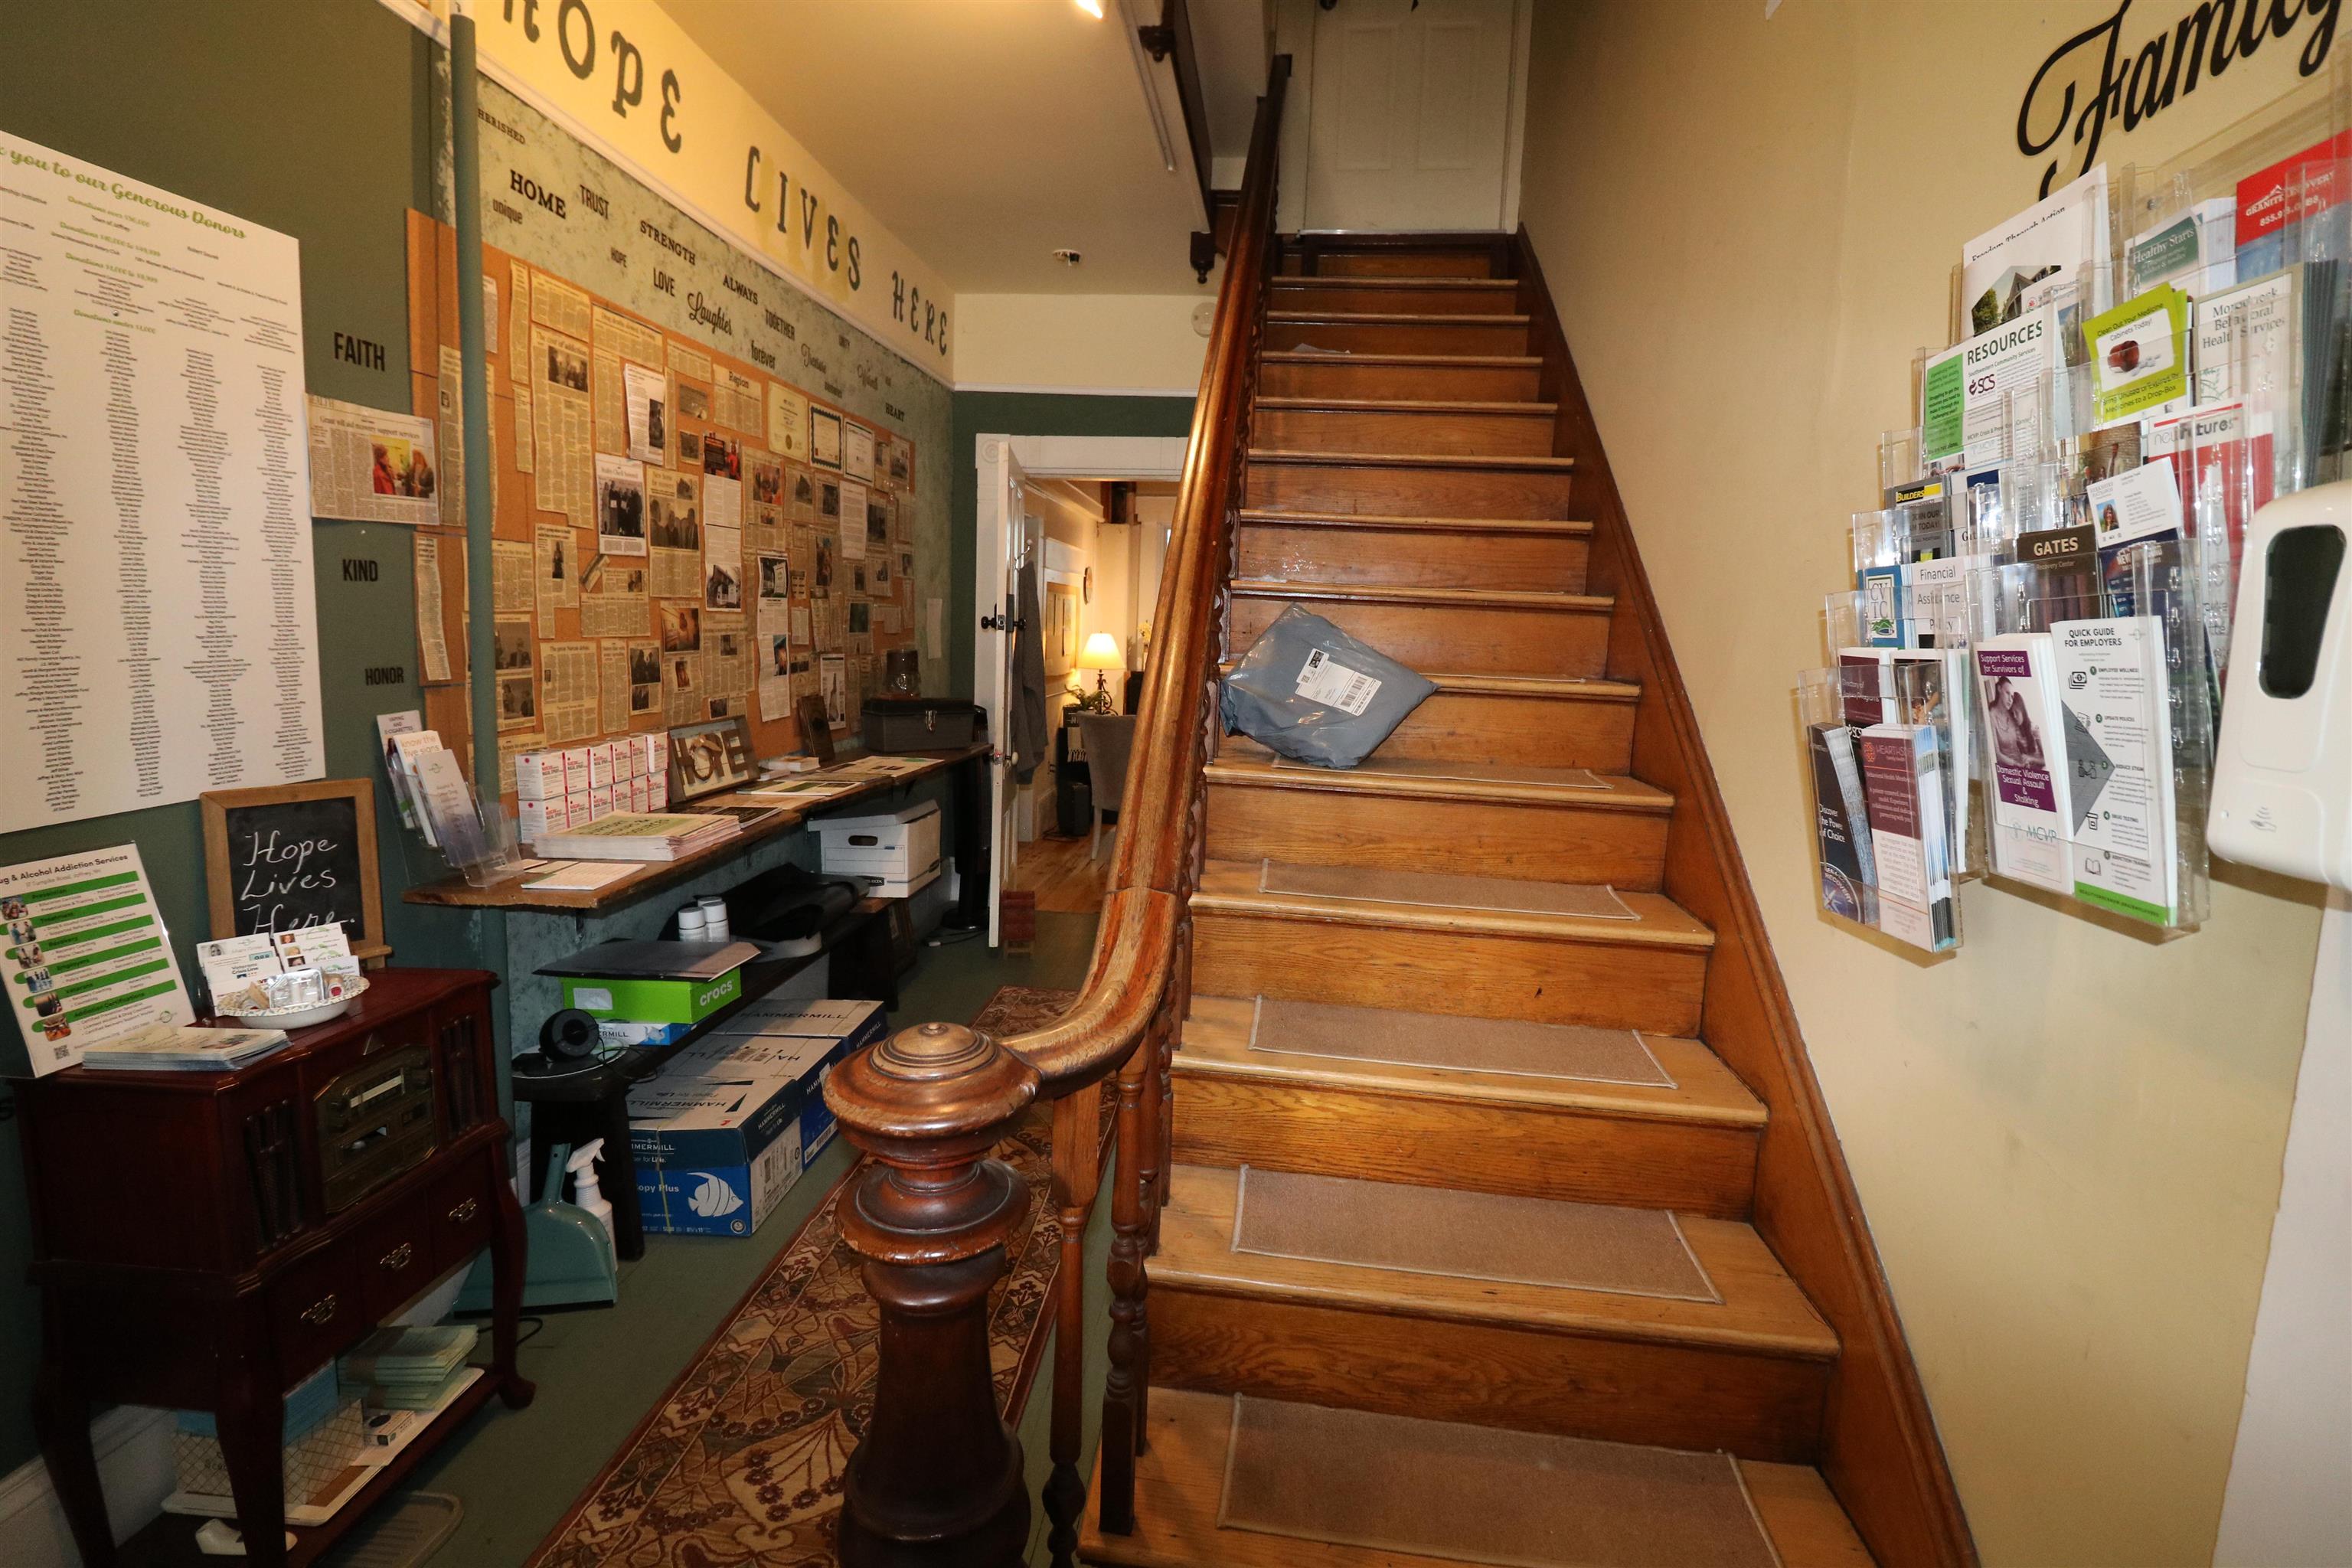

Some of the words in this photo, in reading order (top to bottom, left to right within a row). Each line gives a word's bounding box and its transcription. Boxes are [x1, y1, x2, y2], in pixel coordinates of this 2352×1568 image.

[478, 108, 526, 145] HERISHED
[11, 150, 50, 172] you
[52, 162, 72, 178] to
[75, 174, 109, 191] our
[111, 182, 189, 220] Generous
[191, 211, 247, 240] Donors
[510, 169, 566, 219] HOME
[580, 184, 609, 220] TRUST
[2246, 193, 2285, 217] GRANITE
[492, 198, 523, 224] unique
[640, 220, 696, 266] STRENGTH
[2133, 240, 2169, 264] Healthy
[2168, 229, 2197, 246] Starts
[610, 247, 628, 268] HOPE
[653, 267, 675, 297] LOVE
[722, 274, 759, 305] ALWAYS
[687, 291, 732, 335] Laughter
[892, 270, 947, 356] HERE
[2097, 323, 2115, 337] Clean
[2115, 321, 2125, 331] Out
[2125, 315, 2138, 326] Your
[2138, 302, 2164, 320] Medicine
[765, 309, 795, 341] TOGETHER
[2110, 328, 2133, 341] Cabinets
[334, 332, 386, 371] FAITH
[1967, 320, 2043, 365] RESOURCES
[751, 340, 776, 371] forever
[1968, 364, 1994, 378] Southwestern
[1994, 354, 2018, 370] Community
[2018, 347, 2037, 360] Services
[729, 371, 750, 389] Region
[1978, 374, 1996, 394] SCS
[2147, 385, 2177, 400] Drop-Box
[885, 403, 906, 422] HEART
[1896, 489, 1925, 503] BUILDERS
[2034, 537, 2079, 557] GATES
[342, 558, 378, 582] KIND
[1920, 566, 1956, 581] Financial
[1870, 601, 1889, 618] TC
[2064, 639, 2078, 648] FOR
[2080, 638, 2122, 647] EMPLOYERS
[2069, 629, 2092, 639] QUICK
[2092, 628, 2115, 636] GUIDE
[1980, 653, 2001, 665] Support
[2001, 653, 2025, 664] Services
[1983, 664, 1991, 675] for
[1991, 664, 2018, 674] Survivors
[2018, 664, 2025, 675] of
[364, 666, 404, 686] HONOR
[402, 738, 421, 747] know
[403, 748, 419, 756] five
[420, 744, 439, 753] signs
[1996, 765, 2022, 778] Domestic
[2022, 769, 2050, 782] Violence
[2002, 773, 2022, 786] Sexual
[2022, 778, 2045, 790] Assault
[2014, 794, 2040, 808] Stalking
[2022, 786, 2027, 795] &
[2027, 827, 2057, 844] MCVP
[243, 829, 339, 874] Hope
[20, 867, 52, 880] Alcohol
[54, 861, 93, 873] Addiction
[95, 854, 129, 865] Services
[240, 866, 338, 901] Lives
[699, 979, 733, 1008] crocs
[598, 1030, 629, 1038] ERMILL
[758, 1102, 786, 1131] HAMMERMILL
[658, 1184, 680, 1193] Plus
